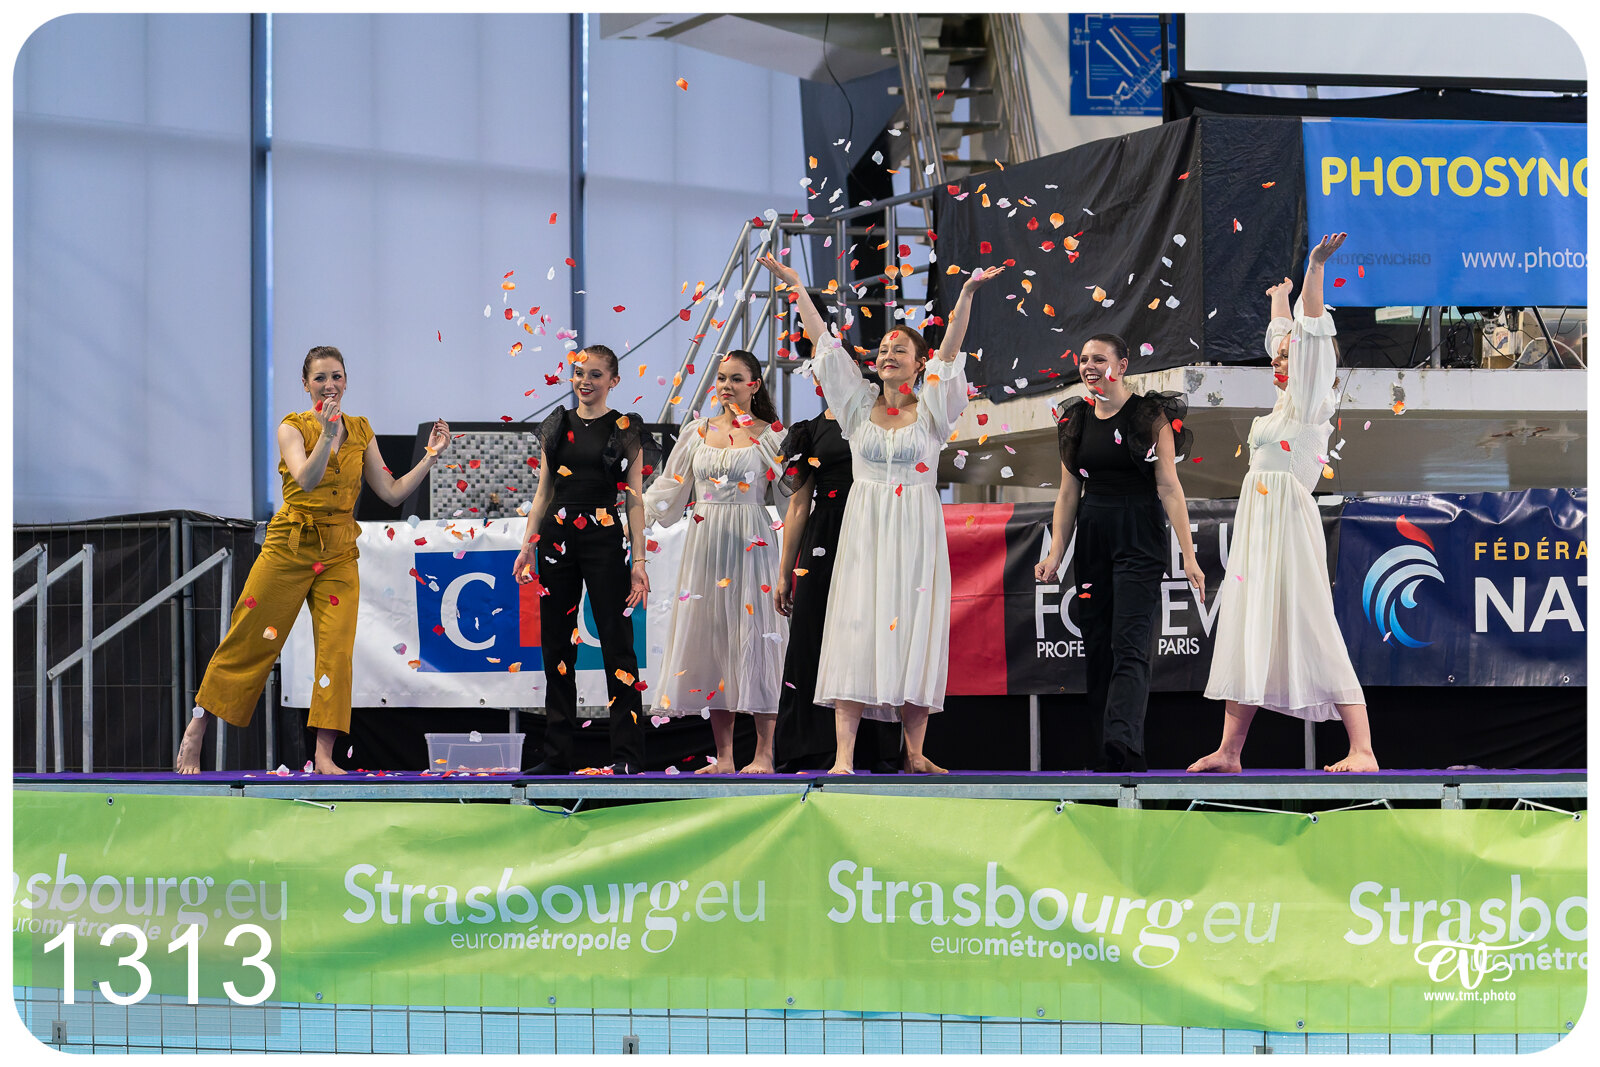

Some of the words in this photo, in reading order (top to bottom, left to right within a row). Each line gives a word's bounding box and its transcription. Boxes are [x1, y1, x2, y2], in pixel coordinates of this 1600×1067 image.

[1462, 247, 1587, 273] www.photo
[1474, 537, 1587, 560] FÉDÉRA
[1475, 576, 1587, 632] NA
[1037, 641, 1086, 658] PROFE
[1158, 637, 1200, 656] PARIS
[342, 863, 767, 954] Strasbourg.eu
[826, 859, 1282, 969] Strasbourg.eu
[450, 925, 631, 956] eurométropole
[930, 931, 1121, 966] eurométropole
